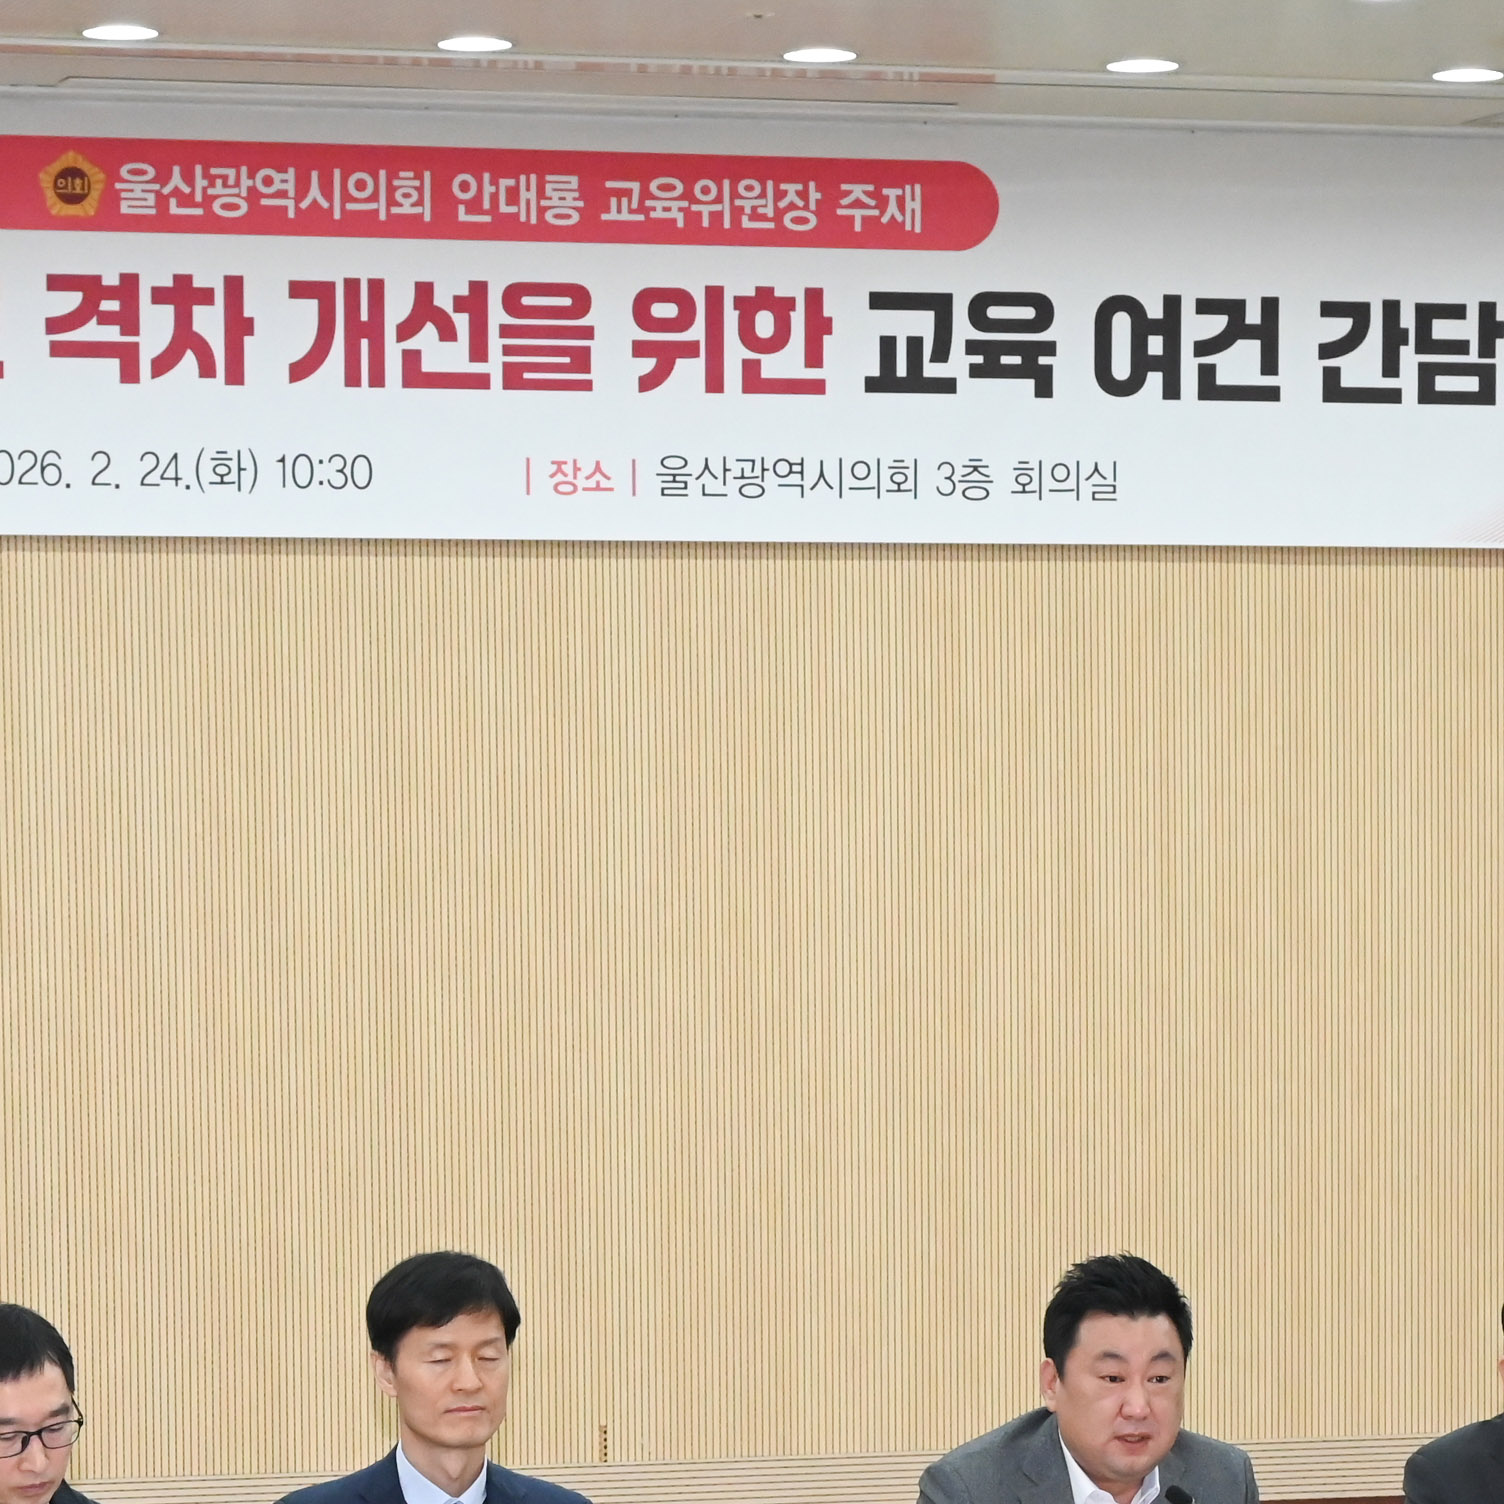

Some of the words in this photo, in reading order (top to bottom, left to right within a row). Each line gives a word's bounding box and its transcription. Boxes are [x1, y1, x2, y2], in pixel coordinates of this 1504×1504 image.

[55, 175, 89, 194] 의회
[114, 162, 432, 223] 울산광역시의회
[452, 172, 586, 227] 안대룡
[599, 175, 823, 232] 교육위원장
[835, 182, 924, 234] 주재
[43, 271, 256, 387] 격차
[287, 277, 596, 393] 개선을
[630, 283, 834, 397] 위한
[863, 290, 1058, 400] 교육
[1093, 292, 1282, 403] 여건
[90, 450, 122, 490] 2.
[138, 446, 259, 495] 24.(화)
[274, 453, 374, 491] 10:30
[548, 457, 616, 497] 장소
[655, 454, 919, 500] 울산광역시의회
[935, 458, 995, 502] 3층
[1009, 459, 1119, 502] 회의실
